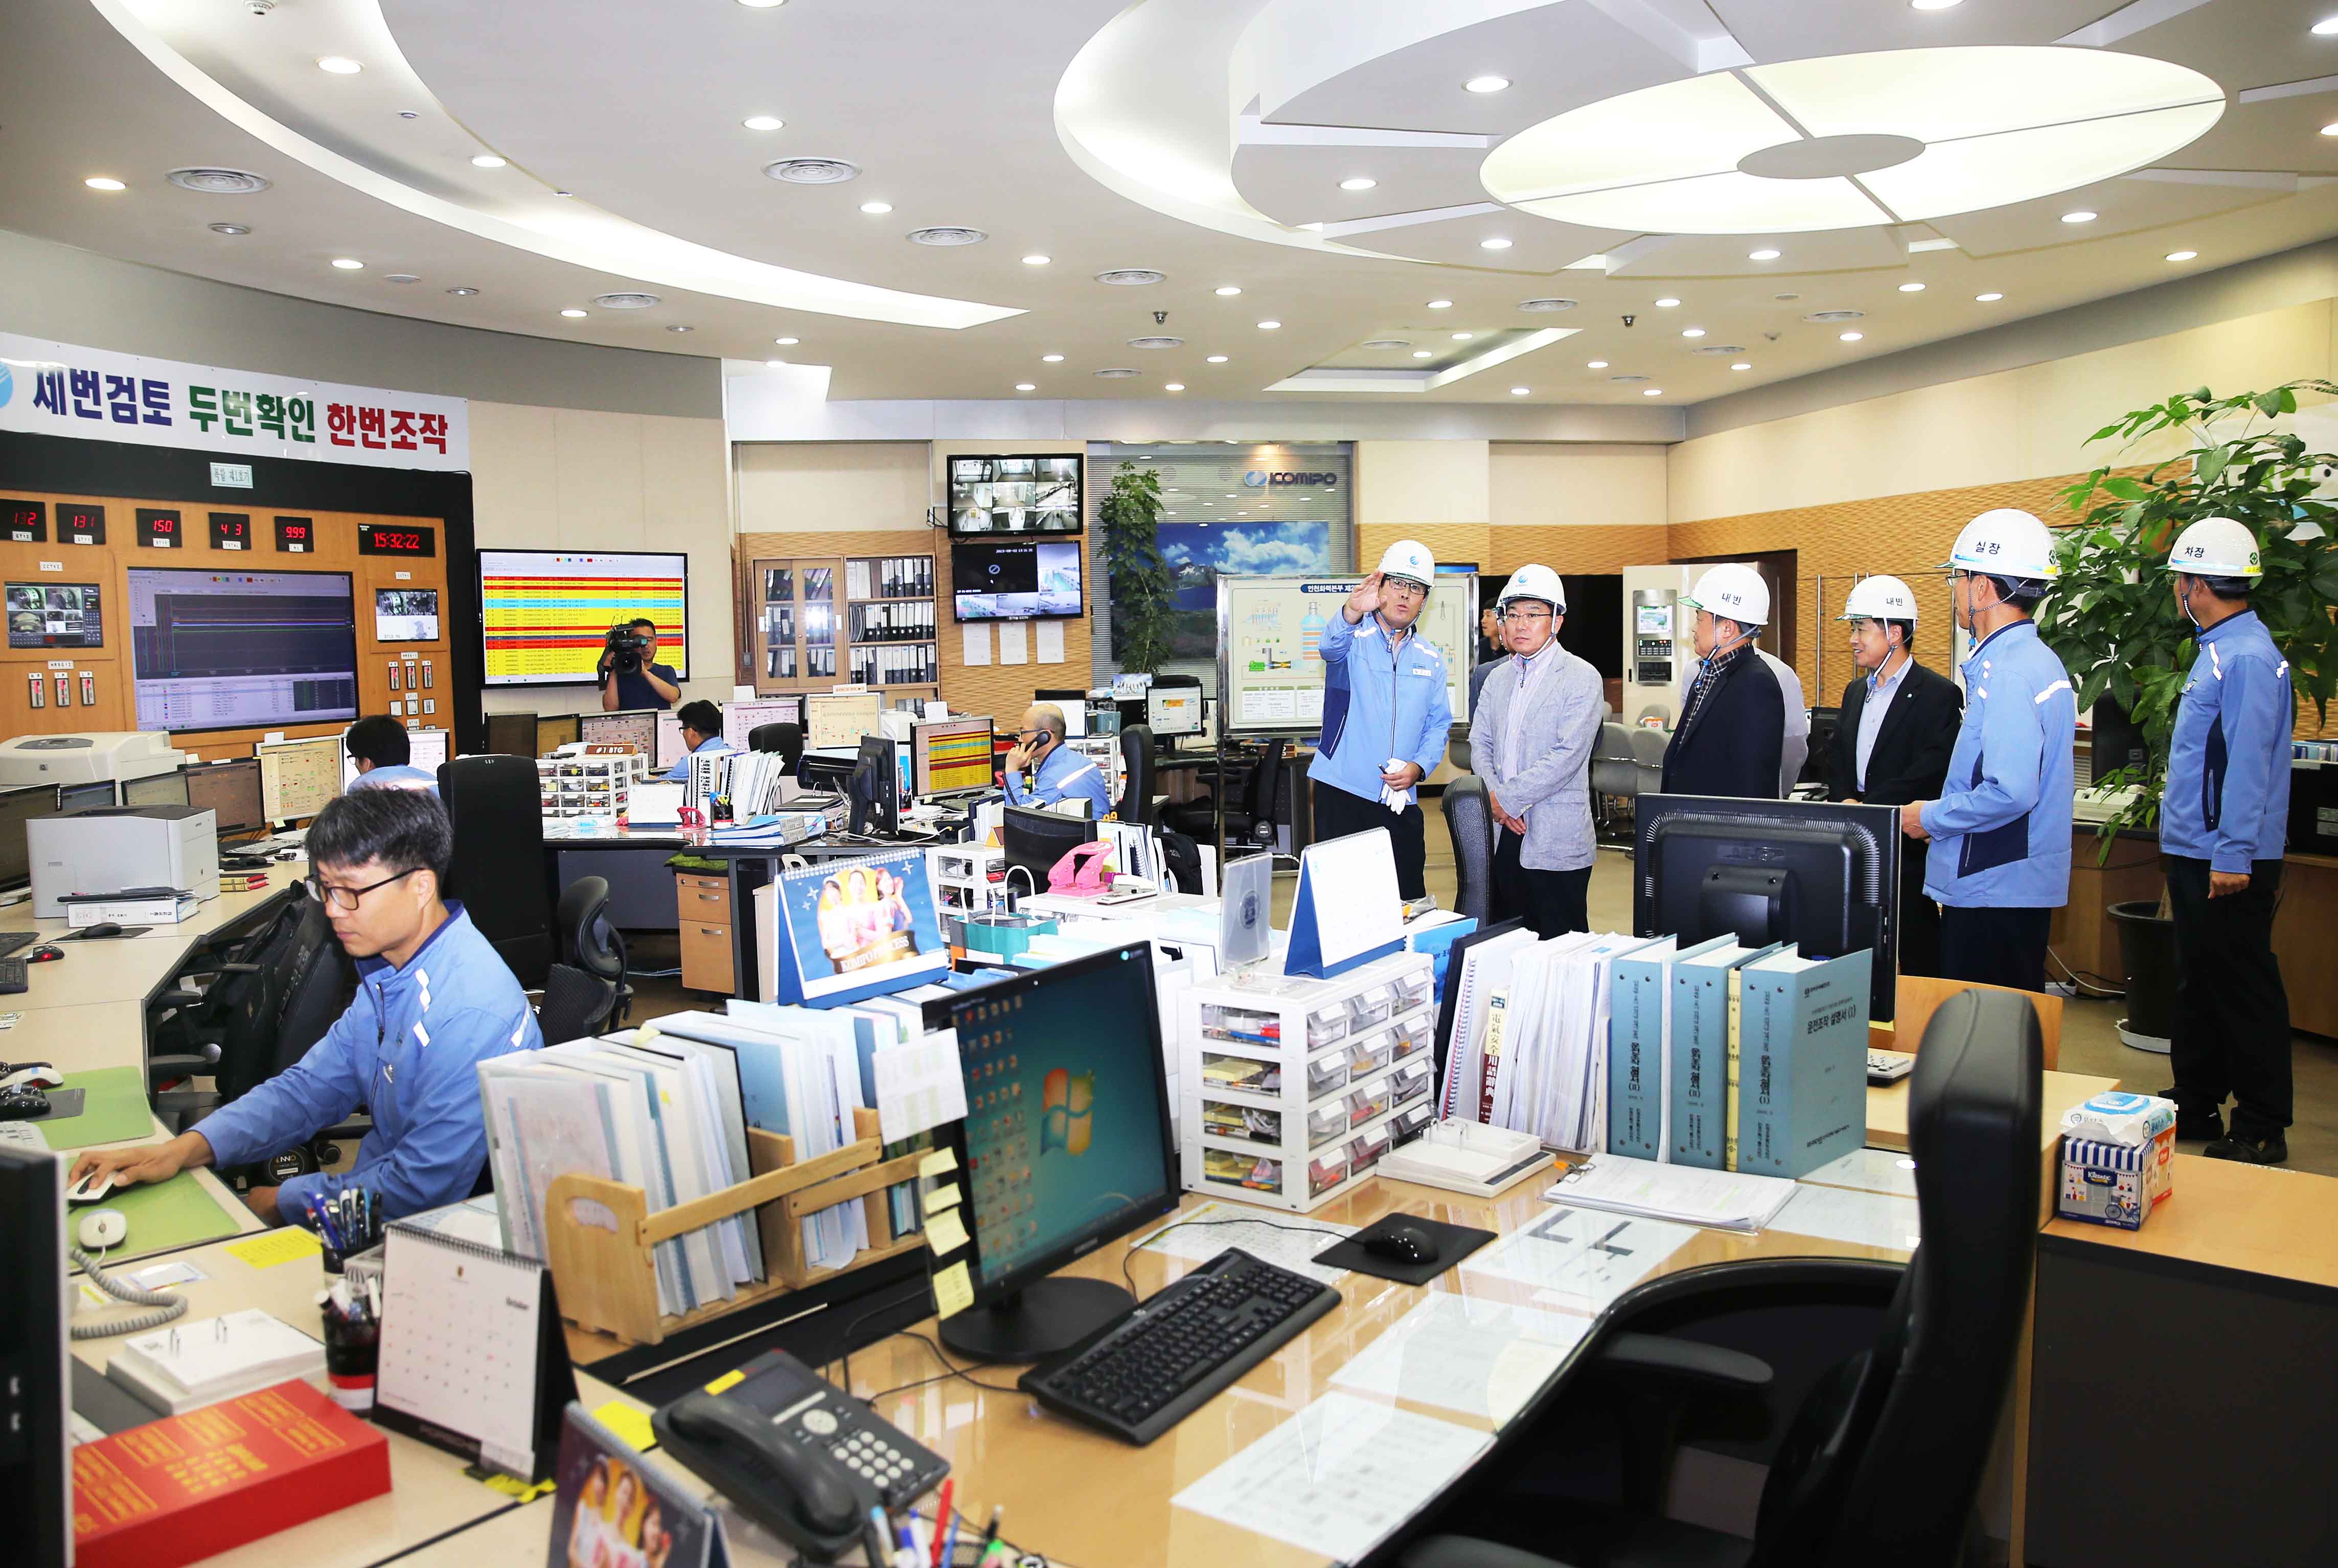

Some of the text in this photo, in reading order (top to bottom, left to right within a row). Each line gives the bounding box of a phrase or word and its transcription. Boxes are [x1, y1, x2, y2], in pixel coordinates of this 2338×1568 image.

[32, 363, 448, 454] 세번검토 두번확인 한번조작
[153, 519, 174, 533] 150
[374, 532, 420, 549] 15:32:22
[1975, 541, 2001, 555] 실장
[2185, 546, 2204, 558] 차장
[1722, 592, 1741, 606] 내빈
[1886, 597, 1903, 606] 내빈
[1807, 1014, 1829, 1034] 운전조작
[1831, 1008, 1846, 1026] 설명서
